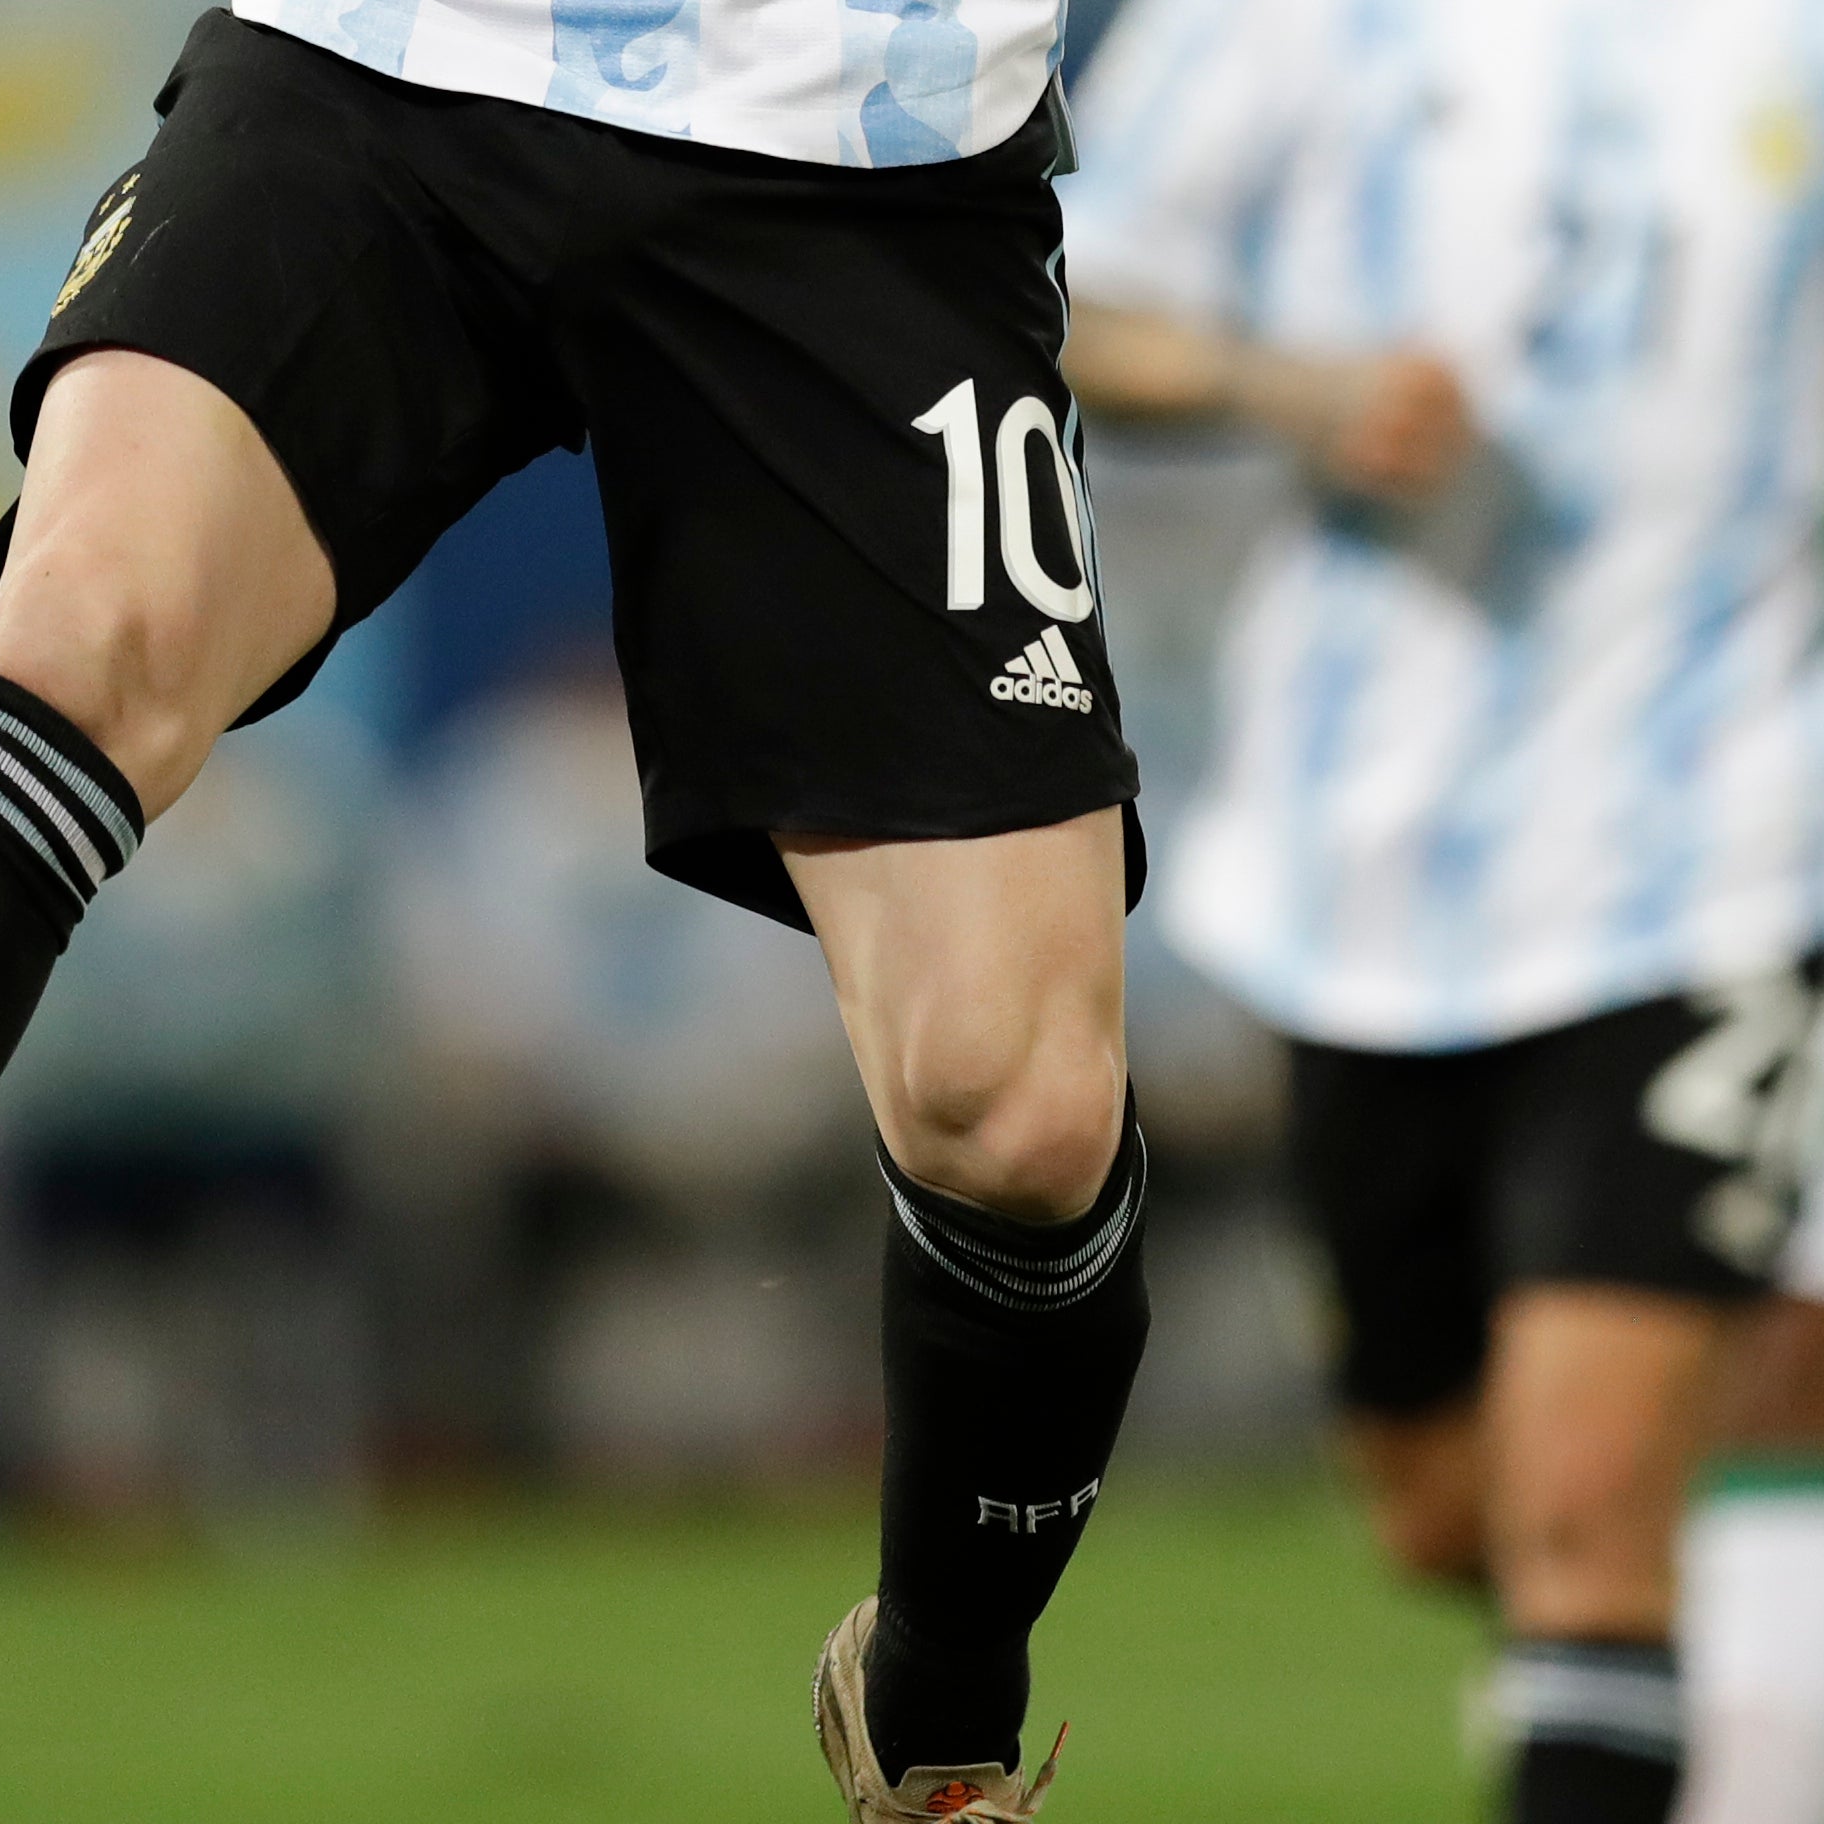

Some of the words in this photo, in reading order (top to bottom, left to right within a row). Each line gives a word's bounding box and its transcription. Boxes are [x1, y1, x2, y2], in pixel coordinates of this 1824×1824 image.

[910, 377, 1095, 623] 10
[989, 673, 1094, 715] adidas
[977, 1477, 1100, 1534] AFA
